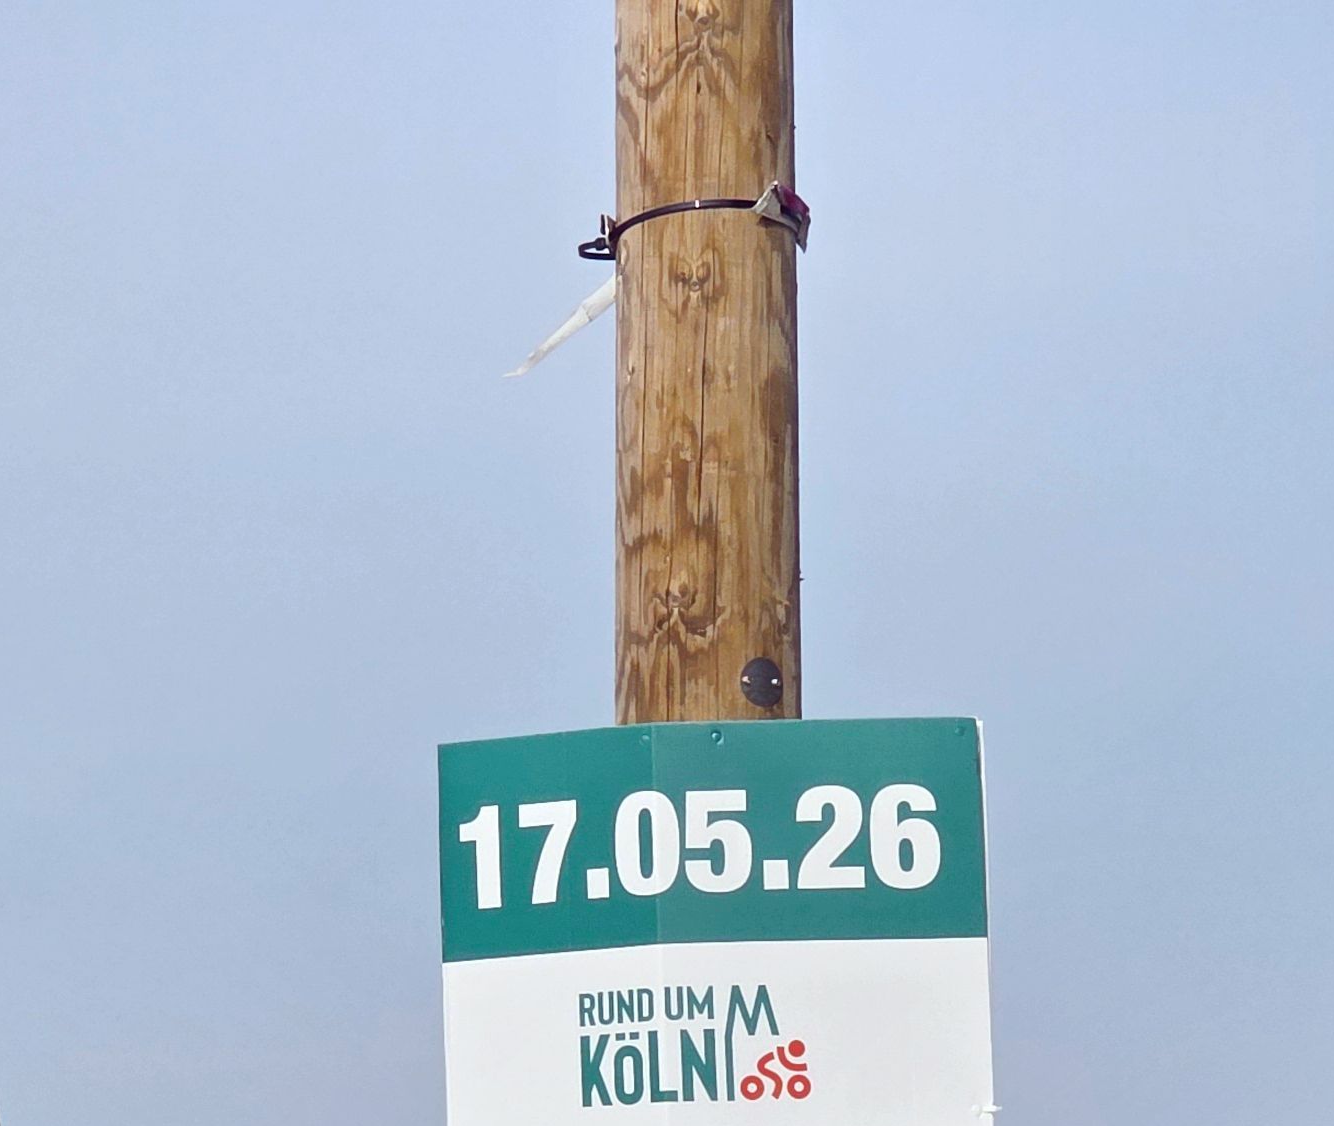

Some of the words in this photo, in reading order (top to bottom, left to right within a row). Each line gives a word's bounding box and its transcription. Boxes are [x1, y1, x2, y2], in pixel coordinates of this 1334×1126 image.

[458, 784, 941, 910] 17.05.26
[579, 989, 654, 1027] RUND
[663, 985, 715, 1021] UM
[579, 1028, 718, 1107] KÖLN
